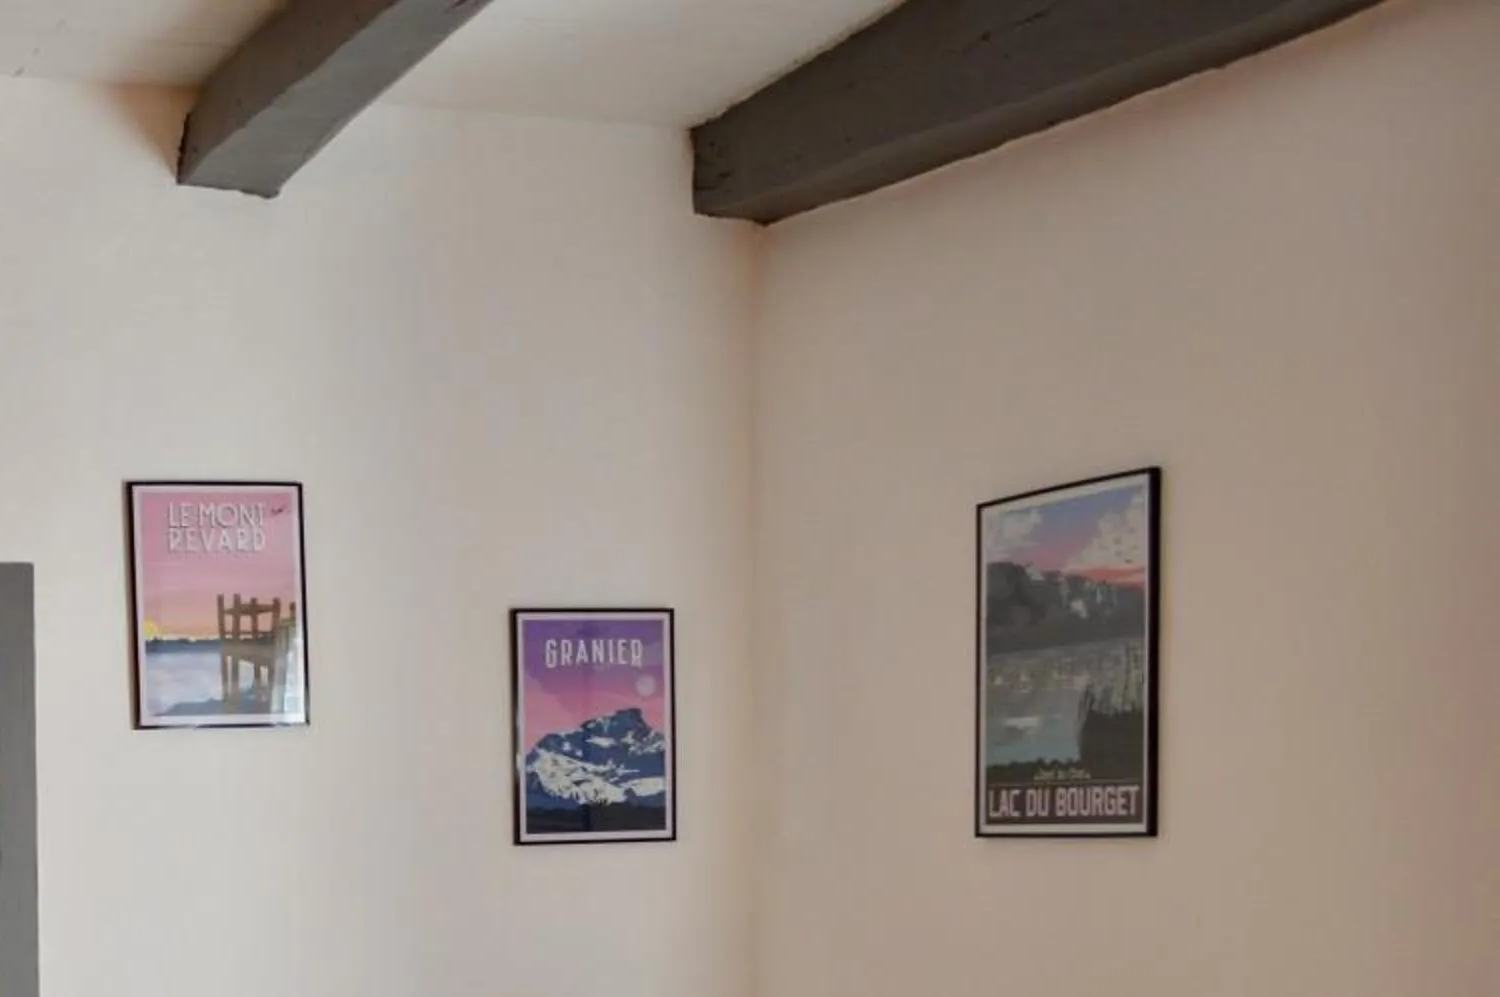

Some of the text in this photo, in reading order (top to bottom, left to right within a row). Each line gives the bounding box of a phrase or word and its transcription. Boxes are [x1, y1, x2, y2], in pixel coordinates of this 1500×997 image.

[168, 501, 266, 529] LE MONT
[168, 527, 267, 552] REVARD
[545, 638, 644, 668] GRANIER
[988, 784, 1140, 818] LAC DU BOURGET
